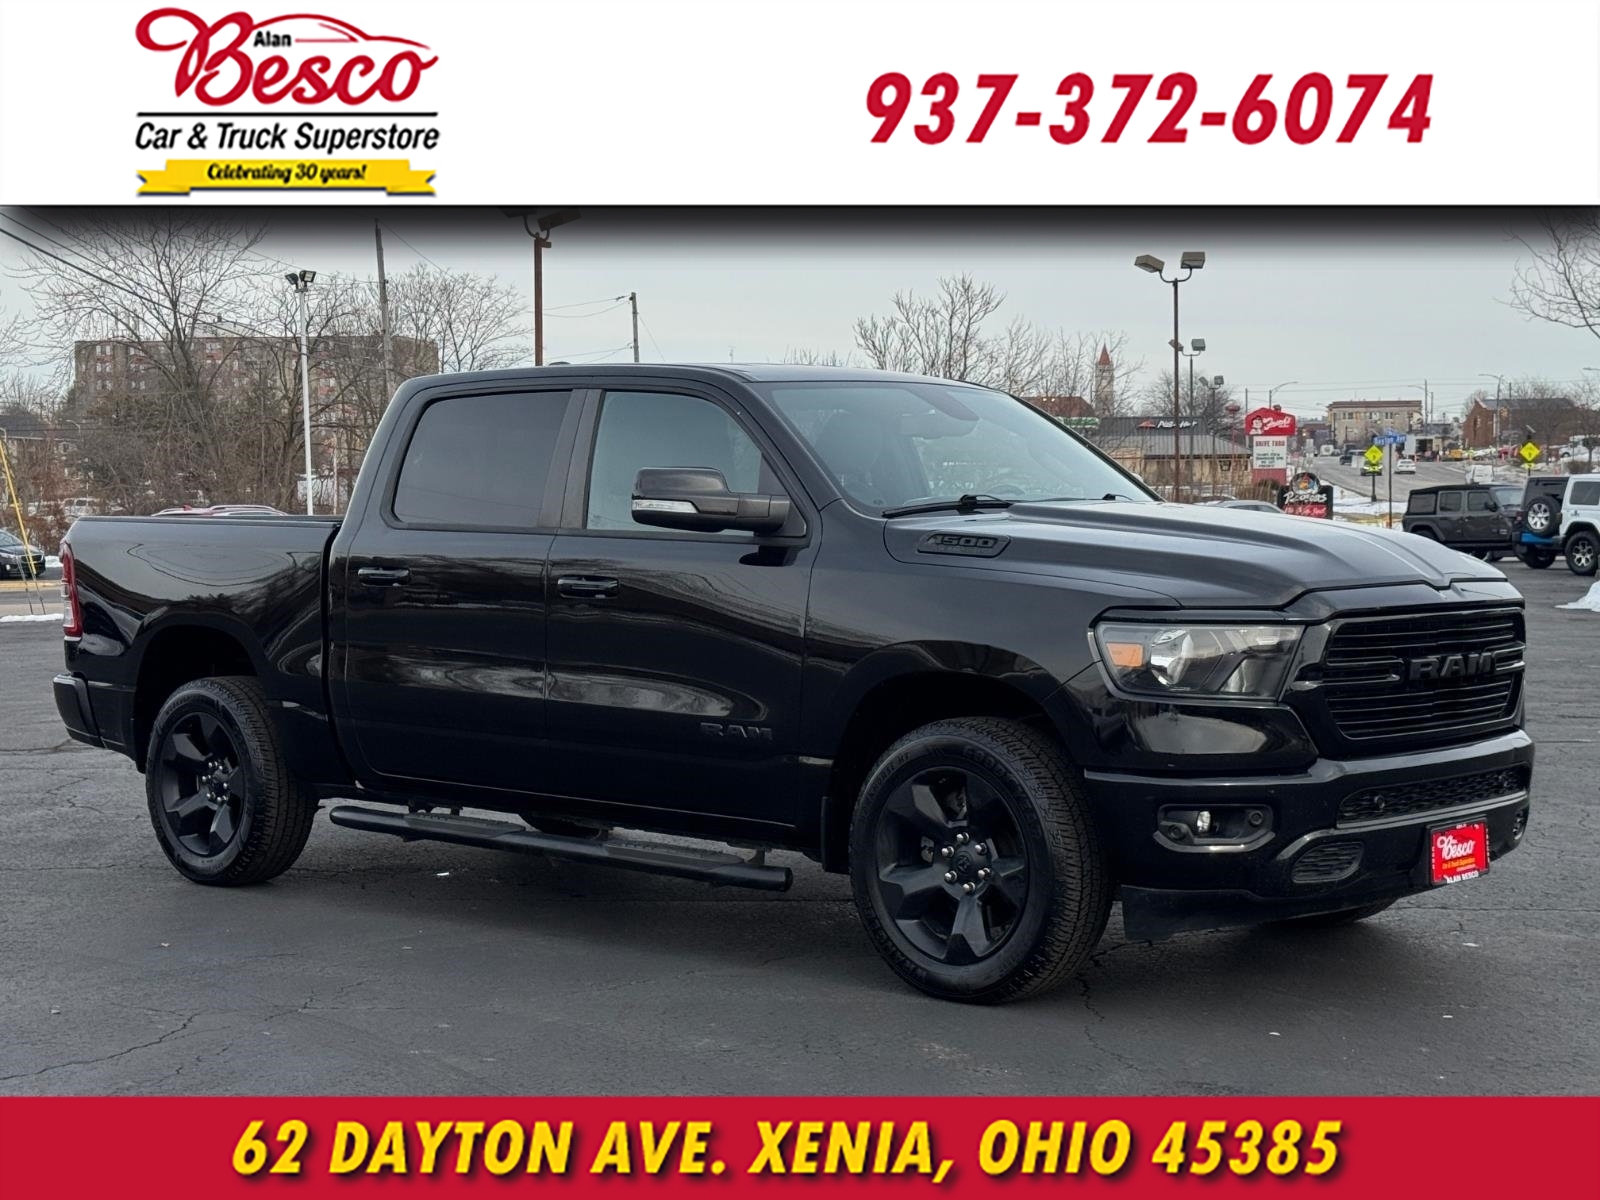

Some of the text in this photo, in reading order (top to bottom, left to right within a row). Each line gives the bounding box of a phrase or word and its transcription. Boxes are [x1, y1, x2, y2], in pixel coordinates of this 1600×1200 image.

[927, 535, 995, 549] 1500
[1409, 652, 1492, 681] RAM
[699, 721, 775, 742] RAM
[1436, 834, 1476, 860] Besco
